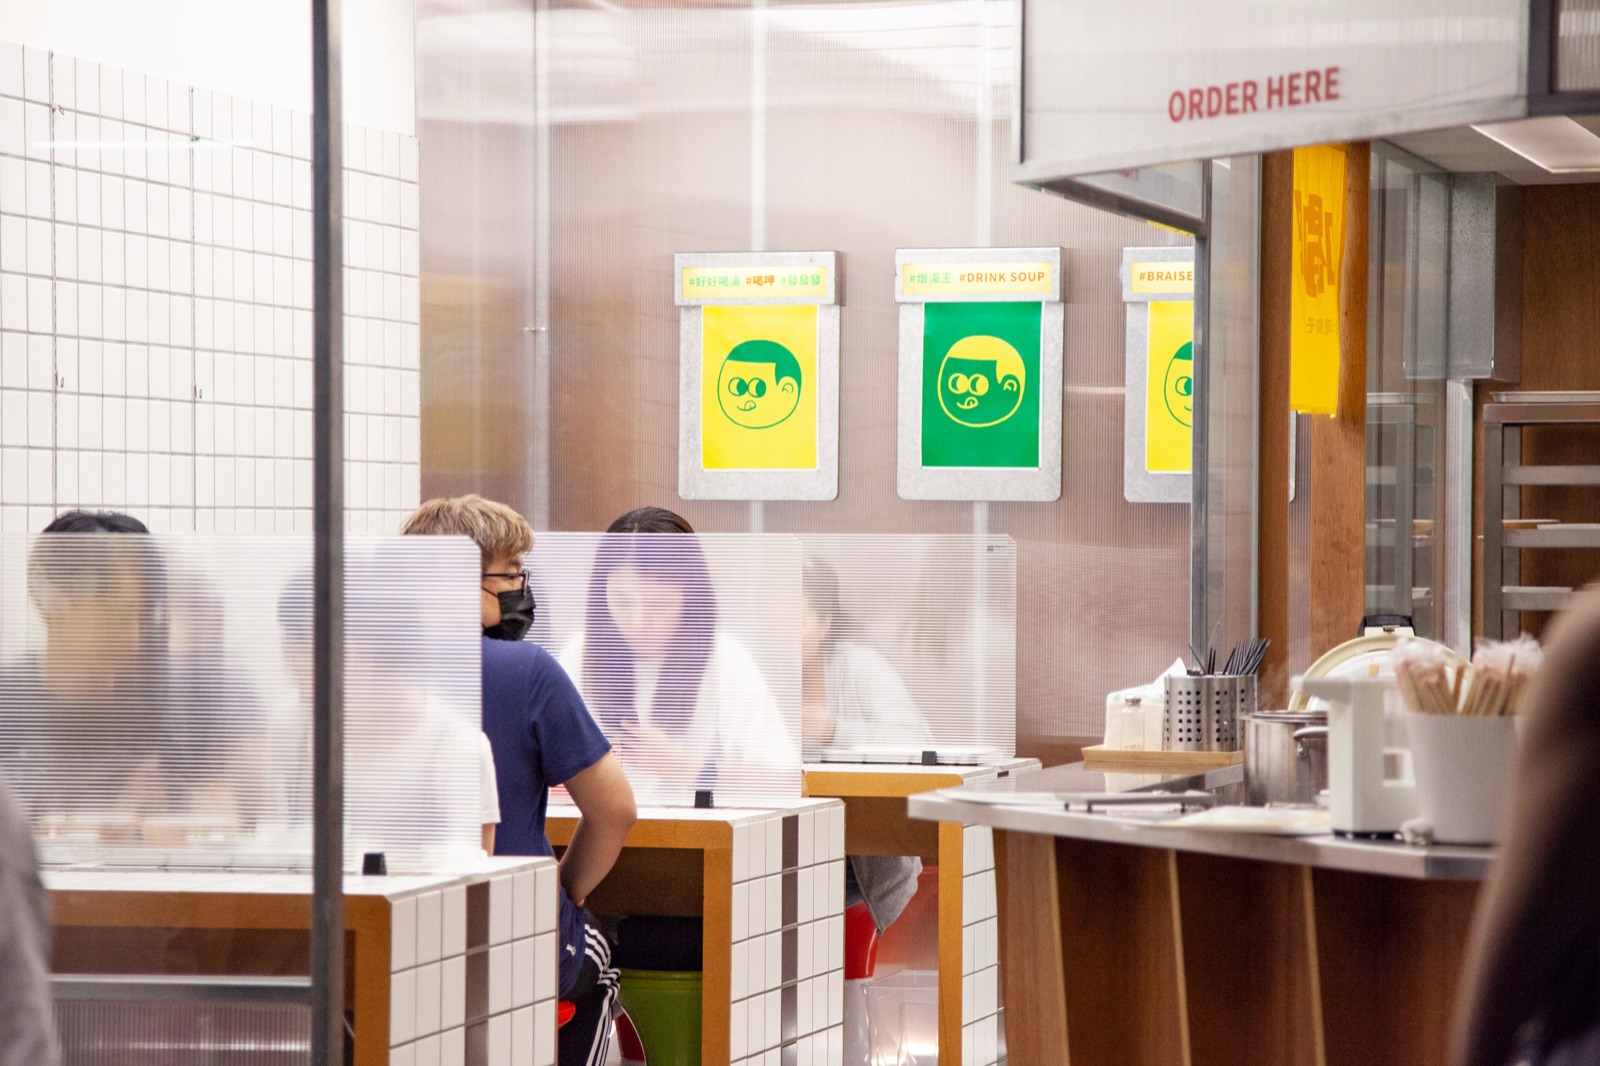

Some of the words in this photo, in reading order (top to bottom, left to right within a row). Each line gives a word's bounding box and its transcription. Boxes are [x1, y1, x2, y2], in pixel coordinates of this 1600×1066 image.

[1168, 80, 1258, 123] ORDER
[1267, 66, 1340, 109] HERE
[960, 272, 1006, 283] #DRINK
[1010, 271, 1045, 282] SOUP
[1139, 271, 1193, 281] #BRAISE
